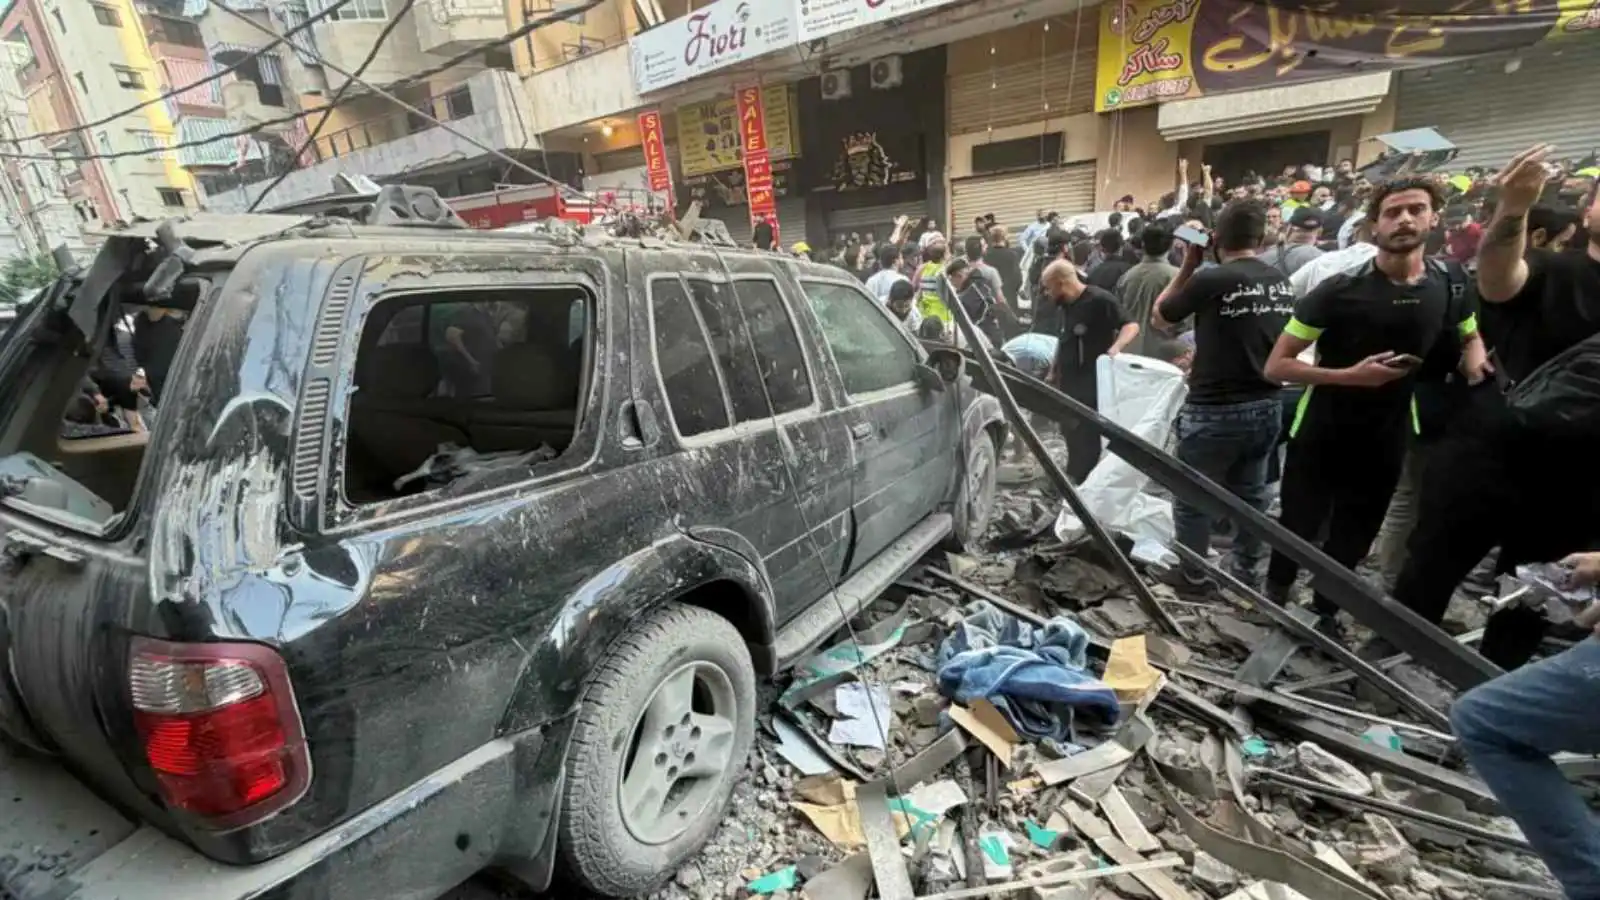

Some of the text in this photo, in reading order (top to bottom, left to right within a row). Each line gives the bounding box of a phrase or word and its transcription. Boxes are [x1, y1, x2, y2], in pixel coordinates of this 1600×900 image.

[684, 12, 747, 66] Fiori
[1118, 38, 1182, 85] سكاكر
[645, 115, 661, 170] SALE
[743, 89, 760, 151] SALE
